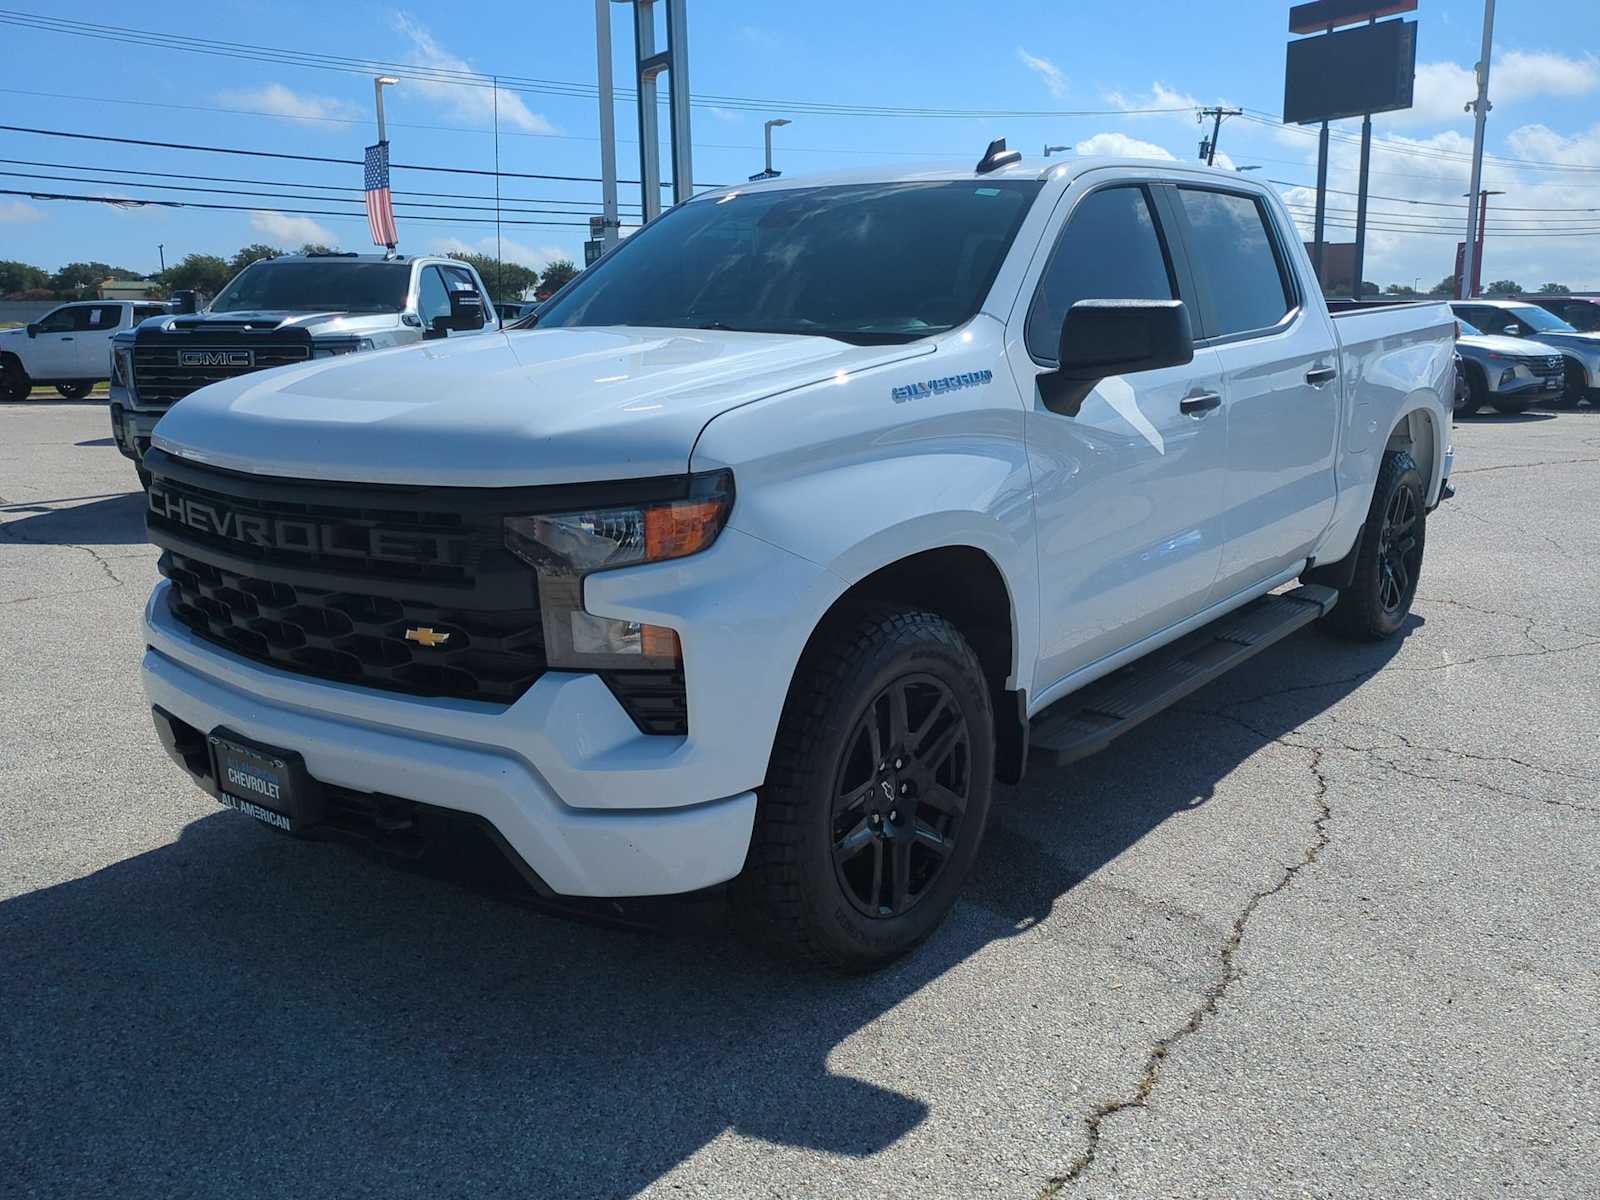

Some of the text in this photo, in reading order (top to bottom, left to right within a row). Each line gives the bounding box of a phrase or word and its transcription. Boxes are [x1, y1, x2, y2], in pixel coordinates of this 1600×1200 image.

[183, 352, 248, 365] GMC
[147, 484, 468, 566] CHEVROLET
[228, 768, 280, 799] CHEVROLET
[222, 793, 291, 831] ALL AMERICAN
